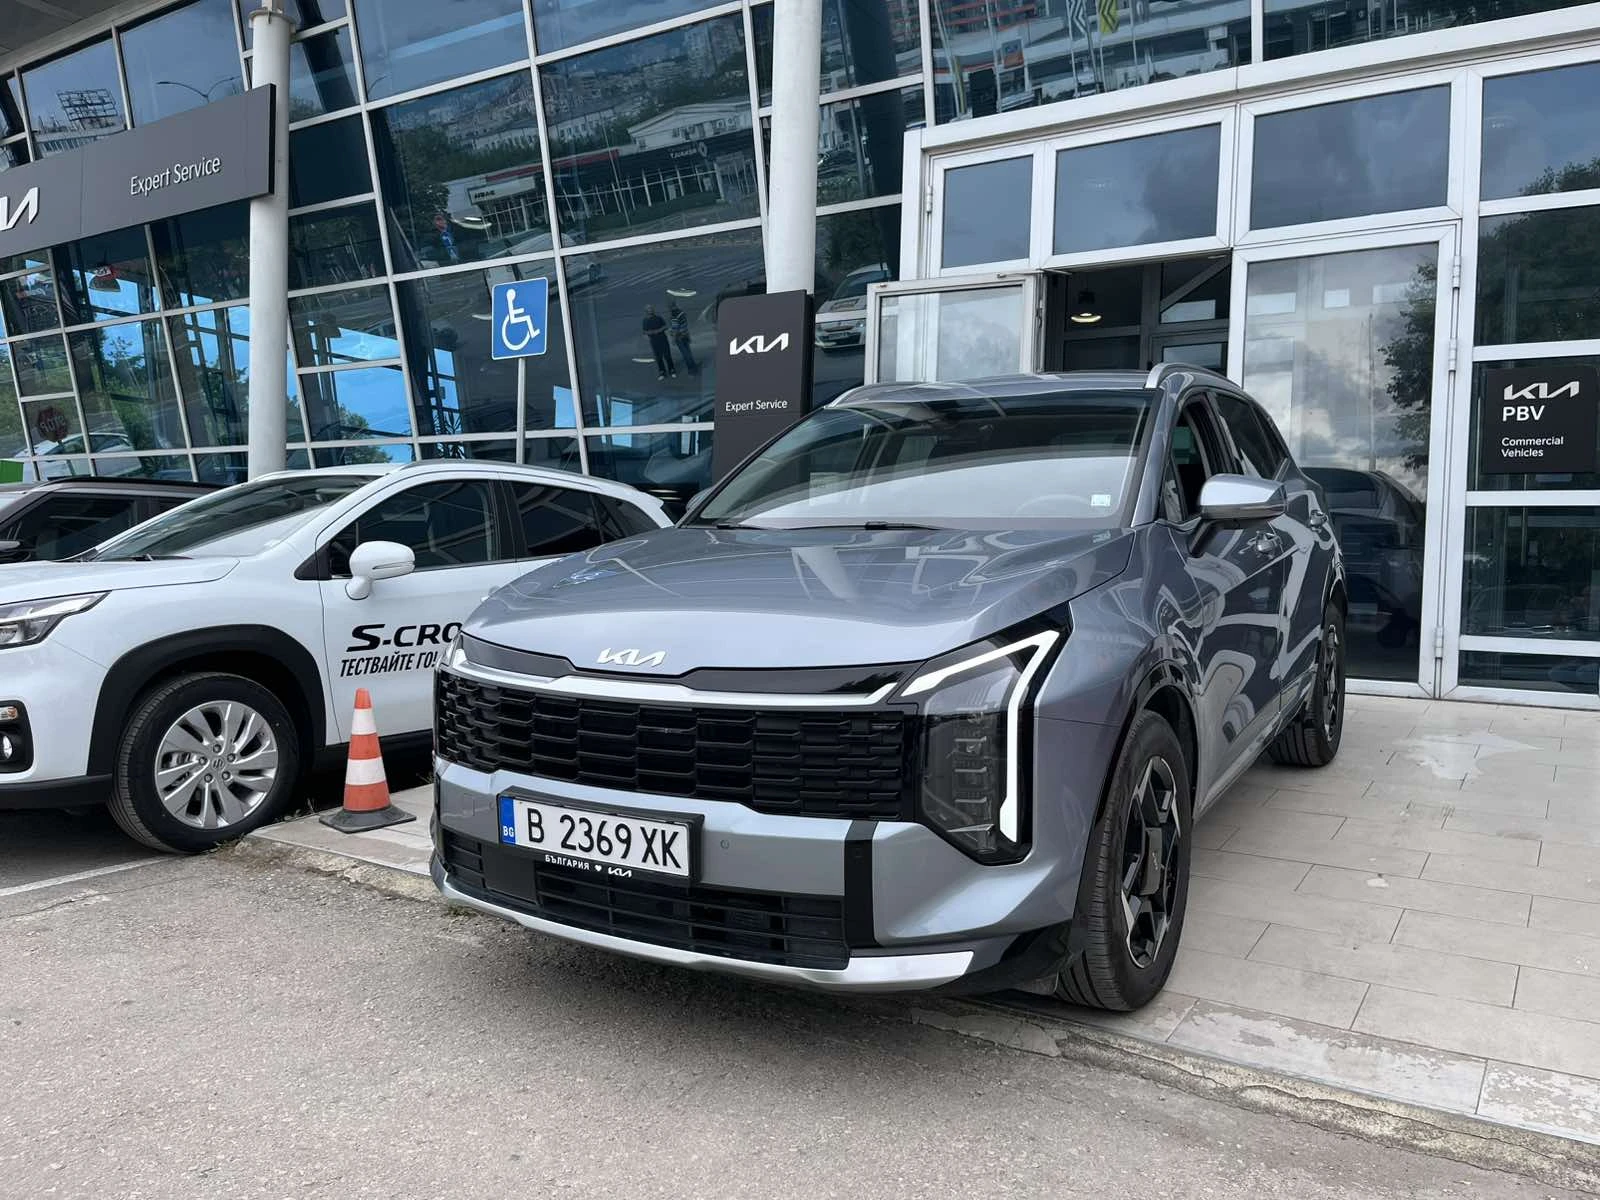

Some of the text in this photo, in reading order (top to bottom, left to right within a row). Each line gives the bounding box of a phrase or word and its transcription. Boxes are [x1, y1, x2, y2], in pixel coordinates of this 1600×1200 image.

[130, 156, 221, 197] Expert Service
[0, 187, 40, 230] IA
[729, 332, 789, 355] KIA
[1503, 381, 1580, 400] KIA
[725, 399, 789, 413] Expert Service
[1502, 405, 1545, 421] PBV
[1501, 436, 1564, 447] Commercial
[1501, 448, 1544, 458] Vehicles
[340, 651, 438, 677] ТЕСТВАЙТЕ ГО!
[596, 647, 667, 667] KIA
[503, 825, 514, 838] BG
[527, 807, 682, 868] B 2369 XK
[544, 854, 632, 878] БЪЛГАРИЯ KIA
